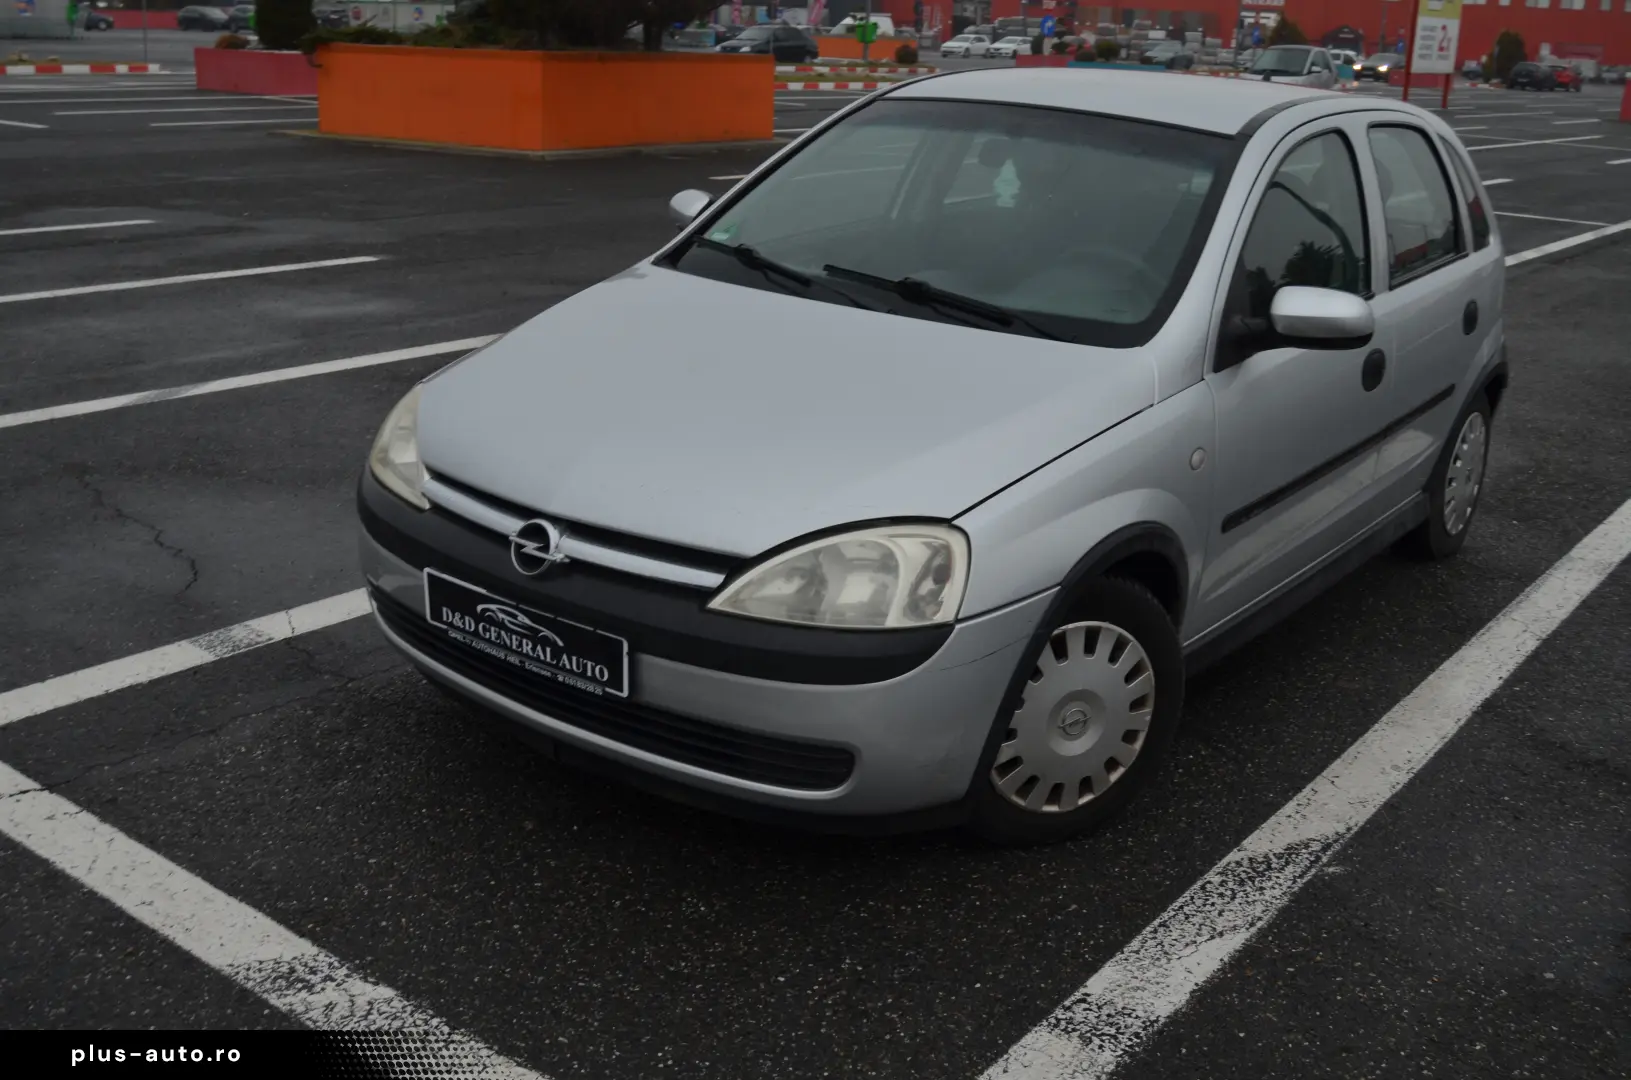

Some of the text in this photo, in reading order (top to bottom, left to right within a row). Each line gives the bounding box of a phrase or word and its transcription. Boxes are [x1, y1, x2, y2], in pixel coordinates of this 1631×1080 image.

[442, 606, 609, 682] D&D GENERAL AUTO
